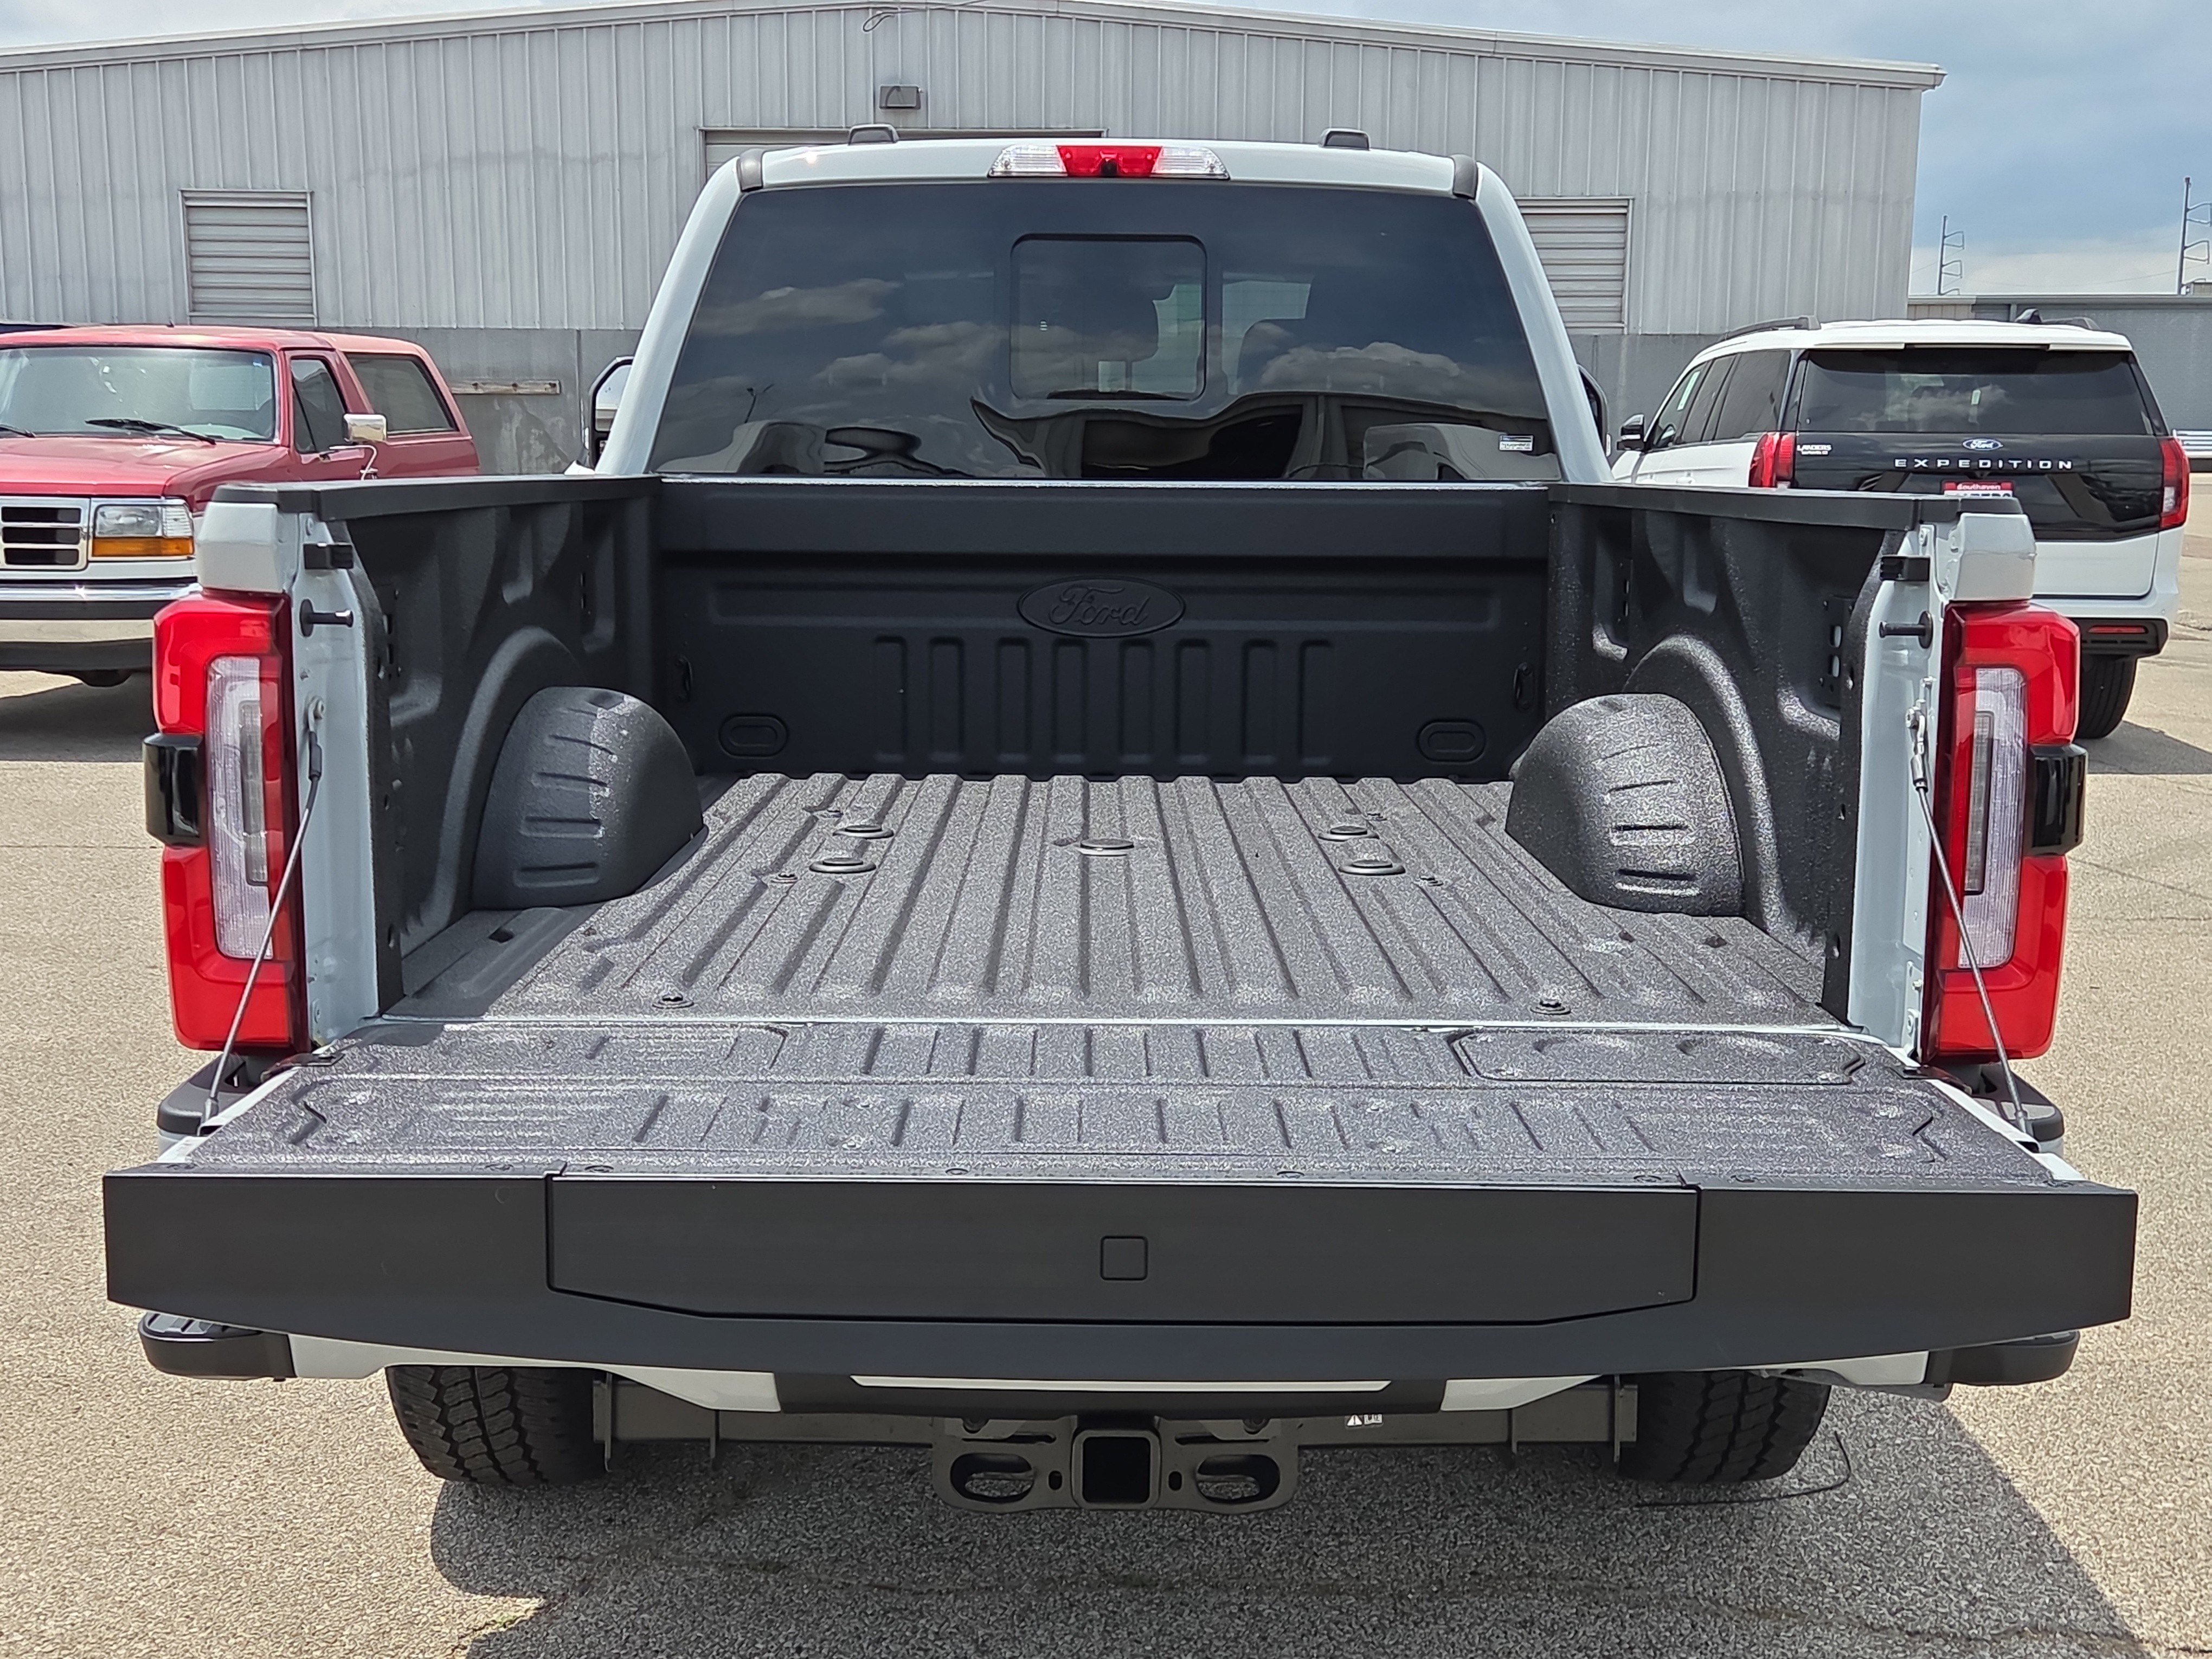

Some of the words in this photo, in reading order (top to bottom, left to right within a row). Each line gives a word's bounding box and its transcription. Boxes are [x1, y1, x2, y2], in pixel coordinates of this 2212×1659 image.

[1970, 439, 1995, 449] Ford
[1895, 459, 2072, 469] EXPEDITION
[1049, 583, 1151, 626] Ford
